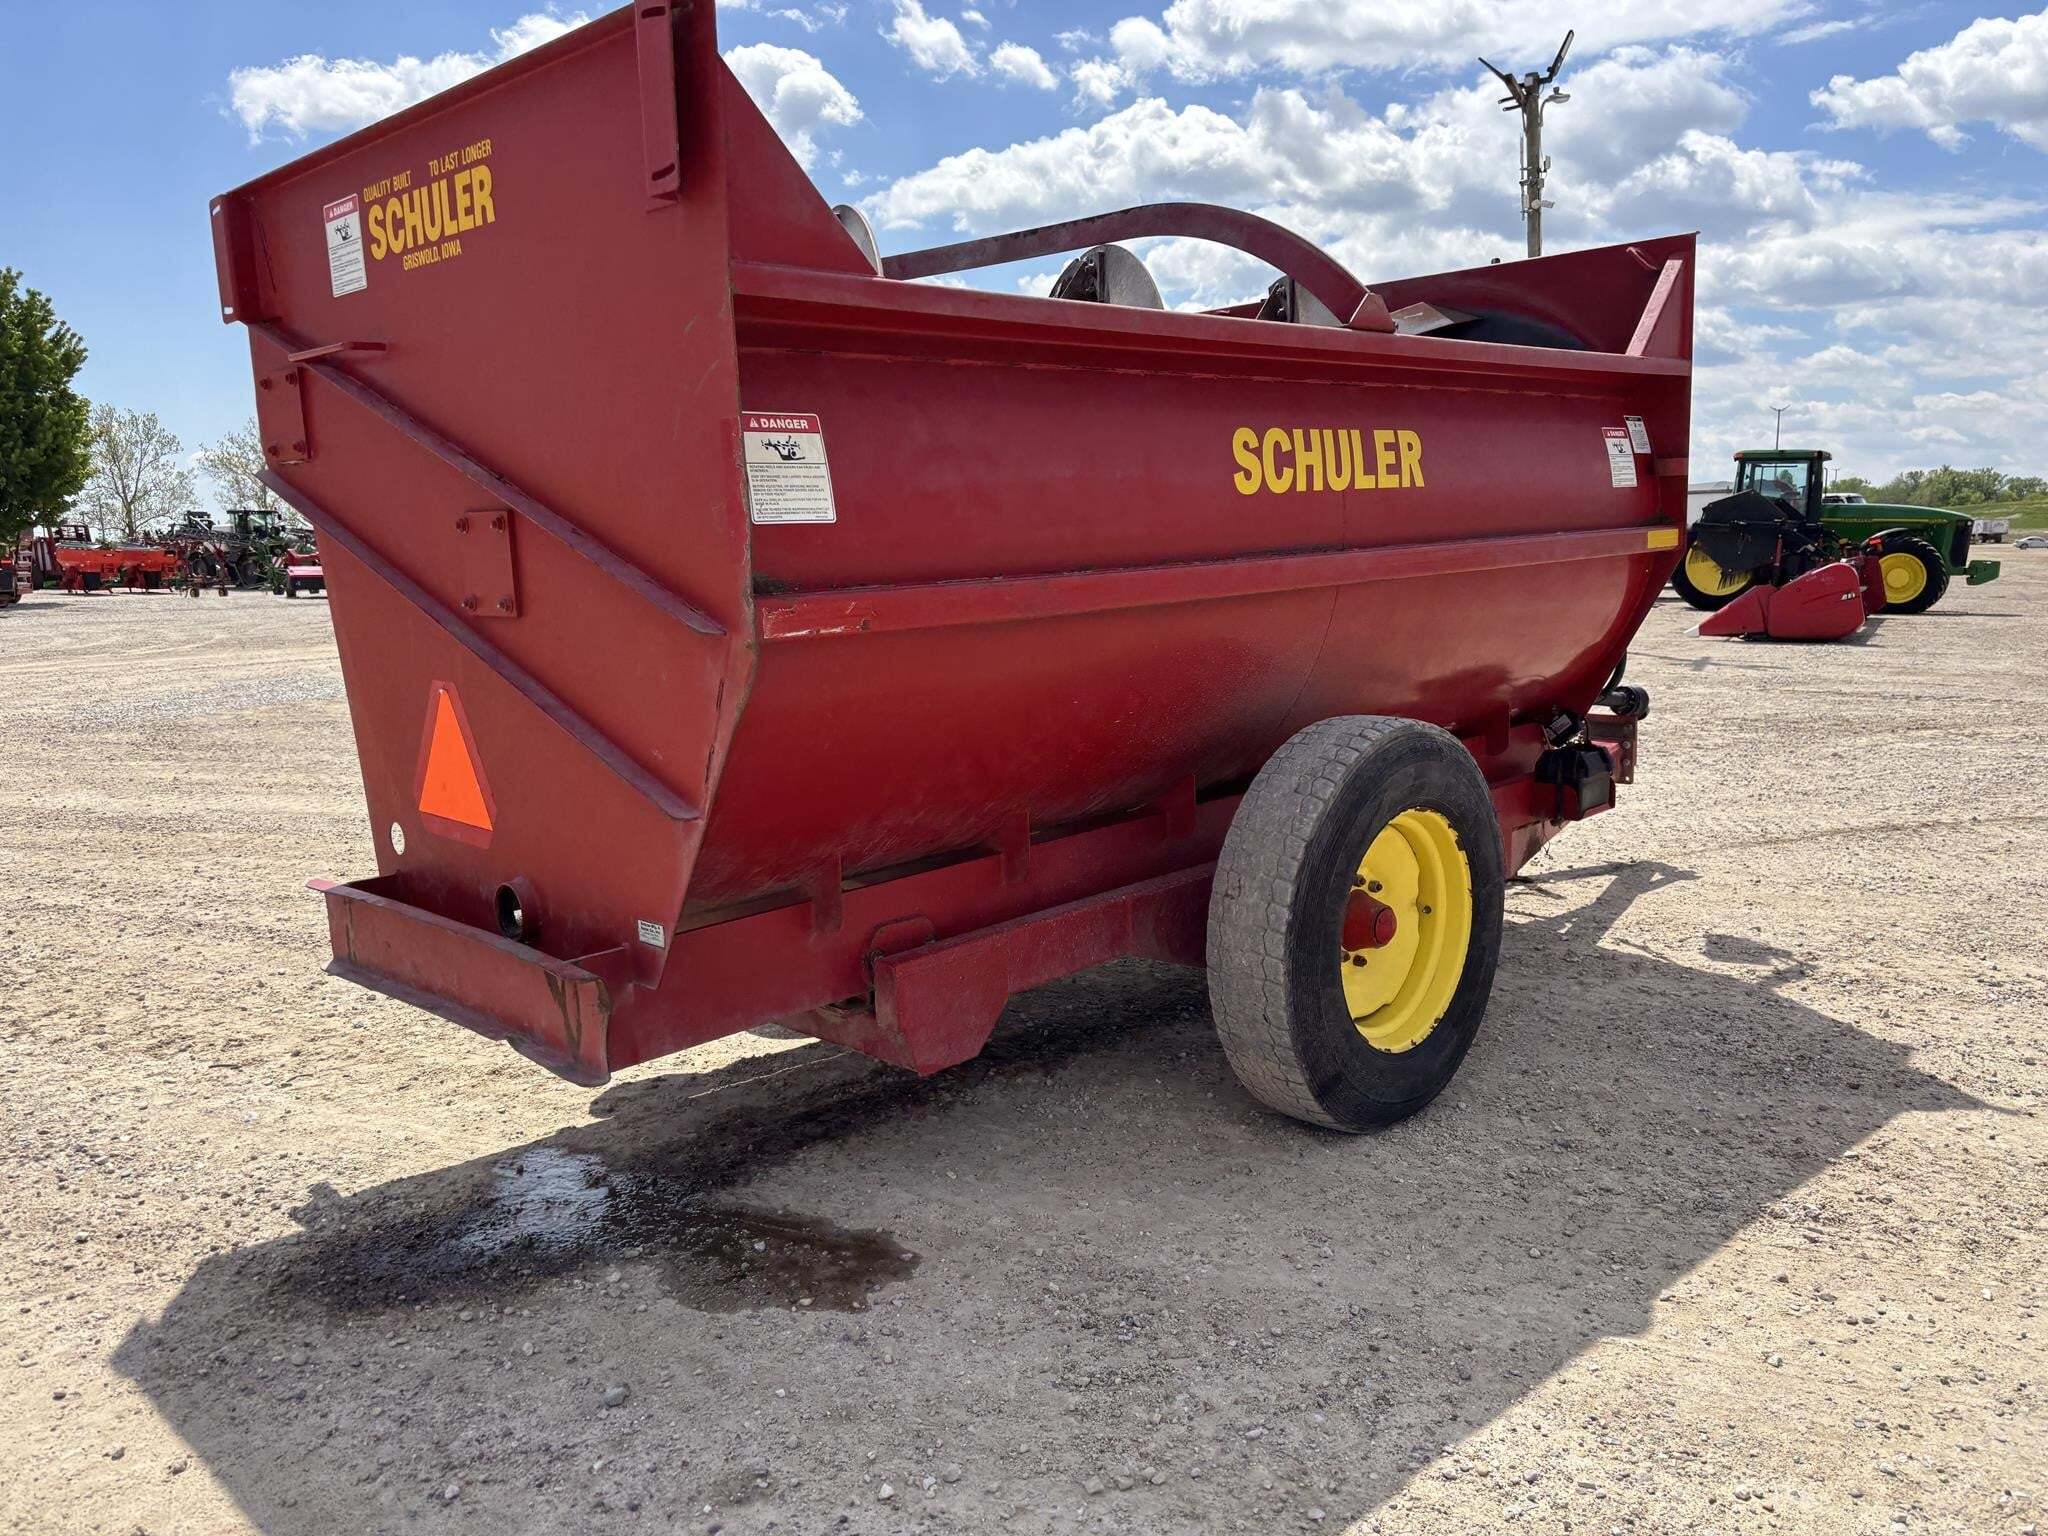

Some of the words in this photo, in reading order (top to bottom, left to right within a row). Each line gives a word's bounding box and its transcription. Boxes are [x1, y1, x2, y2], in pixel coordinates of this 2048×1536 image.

[363, 178, 391, 202] QUALITY
[393, 170, 411, 192] BUILT
[429, 160, 438, 177] TO
[441, 151, 459, 173] LAST
[461, 138, 492, 164] LONGER
[368, 164, 496, 261] SCHULER
[441, 239, 462, 261] IOWA
[760, 418, 809, 429] DANGER
[1232, 427, 1425, 495] SCHULER
